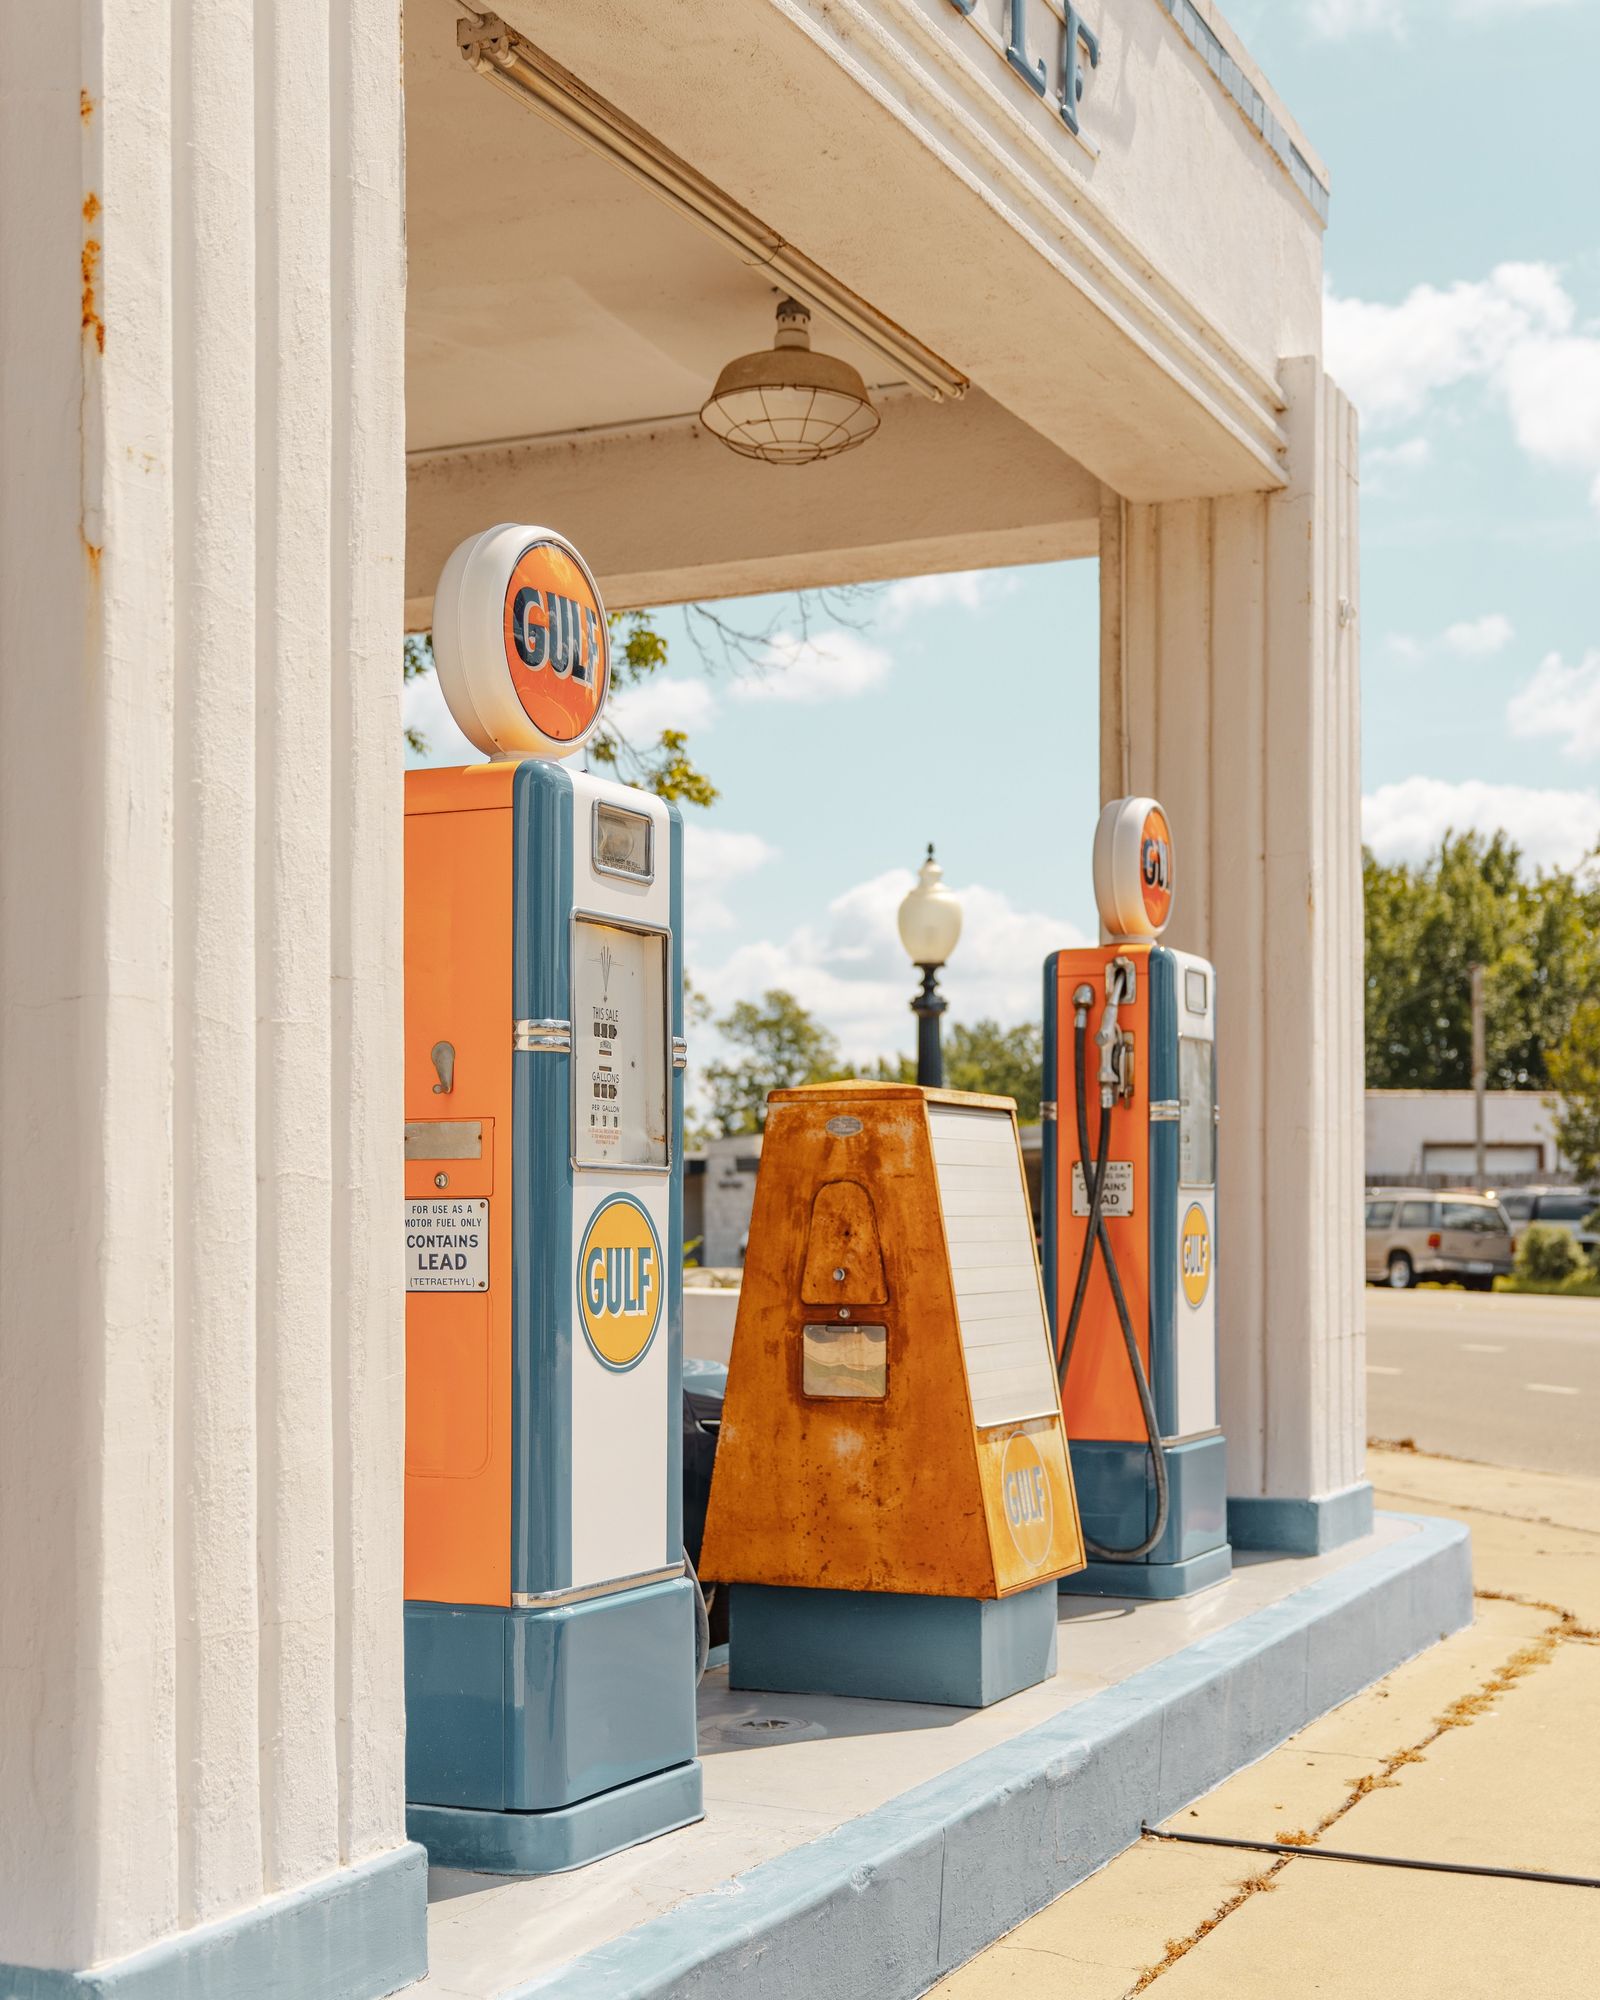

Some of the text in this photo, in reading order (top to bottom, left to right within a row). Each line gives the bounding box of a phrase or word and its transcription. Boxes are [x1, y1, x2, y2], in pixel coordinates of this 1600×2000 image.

[951, 0, 1099, 136] LF
[513, 586, 599, 689] GULF
[593, 1006, 618, 1022] THIS SALE
[592, 1072, 619, 1083] GALLONS
[1079, 1182, 1126, 1191] CAINS
[1088, 1194, 1119, 1205] AD
[412, 1205, 473, 1214] FOR USE AS A
[436, 1218, 456, 1227] FUEL
[461, 1218, 482, 1227] ONLY
[406, 1234, 479, 1248] CONTAINS
[418, 1253, 467, 1270] LEAD
[1184, 1234, 1208, 1277] GULF
[410, 1277, 475, 1287] (TETRAETHYL)
[586, 1246, 653, 1319] GULF
[1006, 1466, 1045, 1527] GULF
